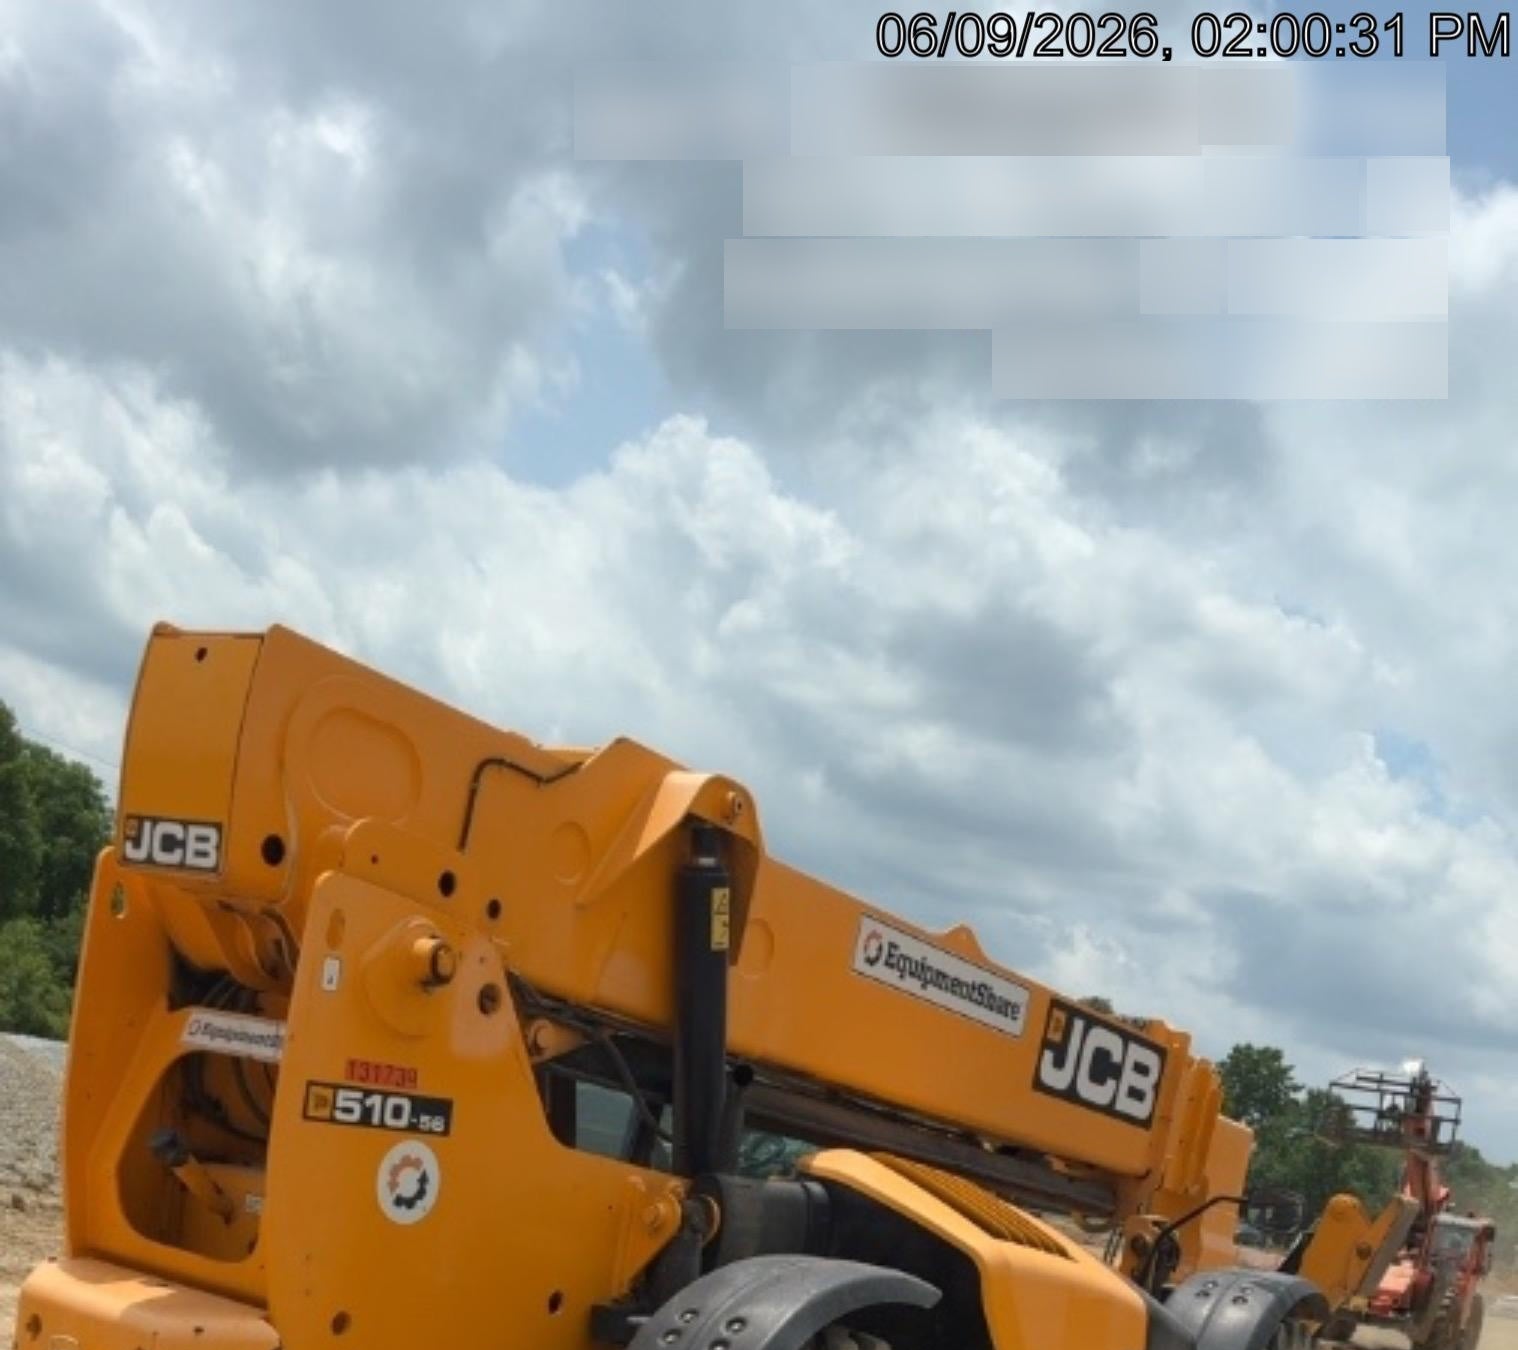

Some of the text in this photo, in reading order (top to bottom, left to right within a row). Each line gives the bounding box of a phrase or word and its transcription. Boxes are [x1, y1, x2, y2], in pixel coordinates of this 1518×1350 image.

[125, 820, 219, 868] JCB
[885, 941, 1021, 1021] EquipmentShare
[1039, 1014, 1163, 1121] JCB
